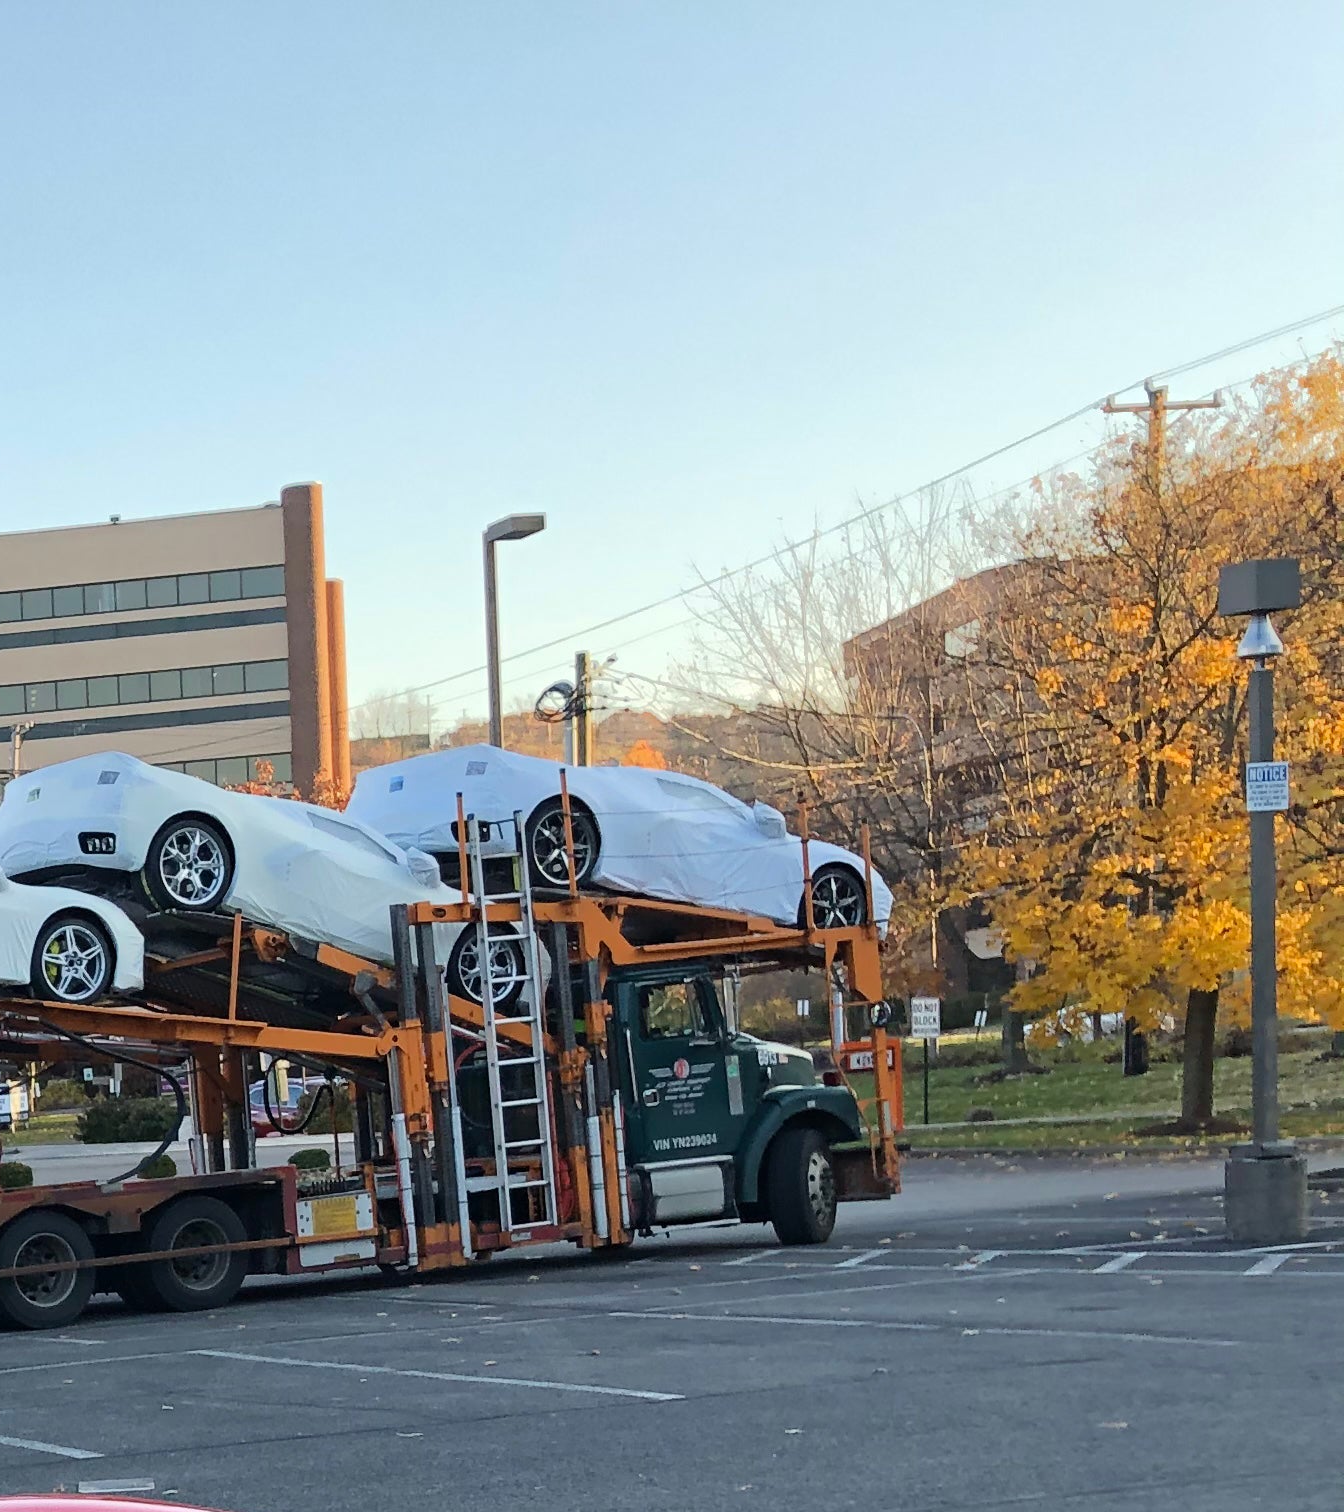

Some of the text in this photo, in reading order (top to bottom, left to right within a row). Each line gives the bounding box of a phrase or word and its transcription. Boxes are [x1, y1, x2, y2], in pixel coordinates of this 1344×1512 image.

[1250, 767, 1286, 781] NOTICE
[913, 1002, 937, 1013] DO NOT
[913, 1015, 937, 1025] BLOCK
[652, 1138, 670, 1151] VIN
